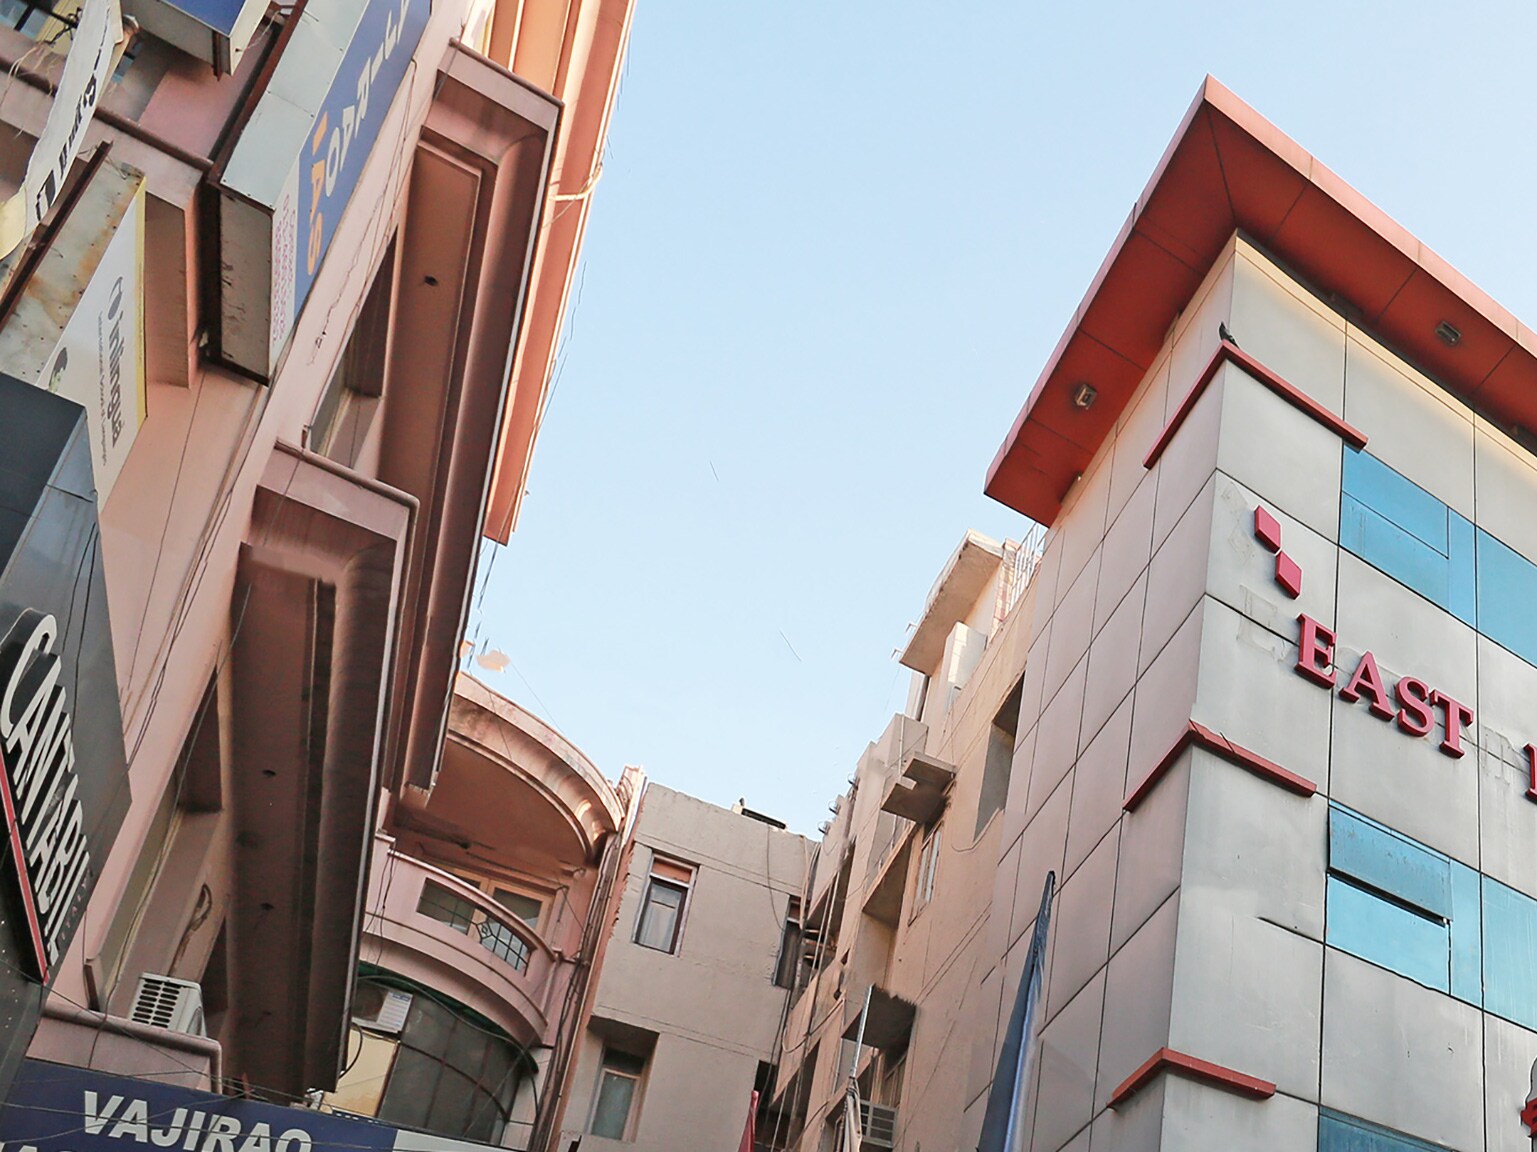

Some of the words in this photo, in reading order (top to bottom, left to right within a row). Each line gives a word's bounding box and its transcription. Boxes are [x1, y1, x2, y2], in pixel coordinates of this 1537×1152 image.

[308, 111, 328, 276] IAS
[108, 310, 124, 449] inlingua
[1295, 612, 1474, 759] EAST
[0, 613, 90, 967] CANTABIL
